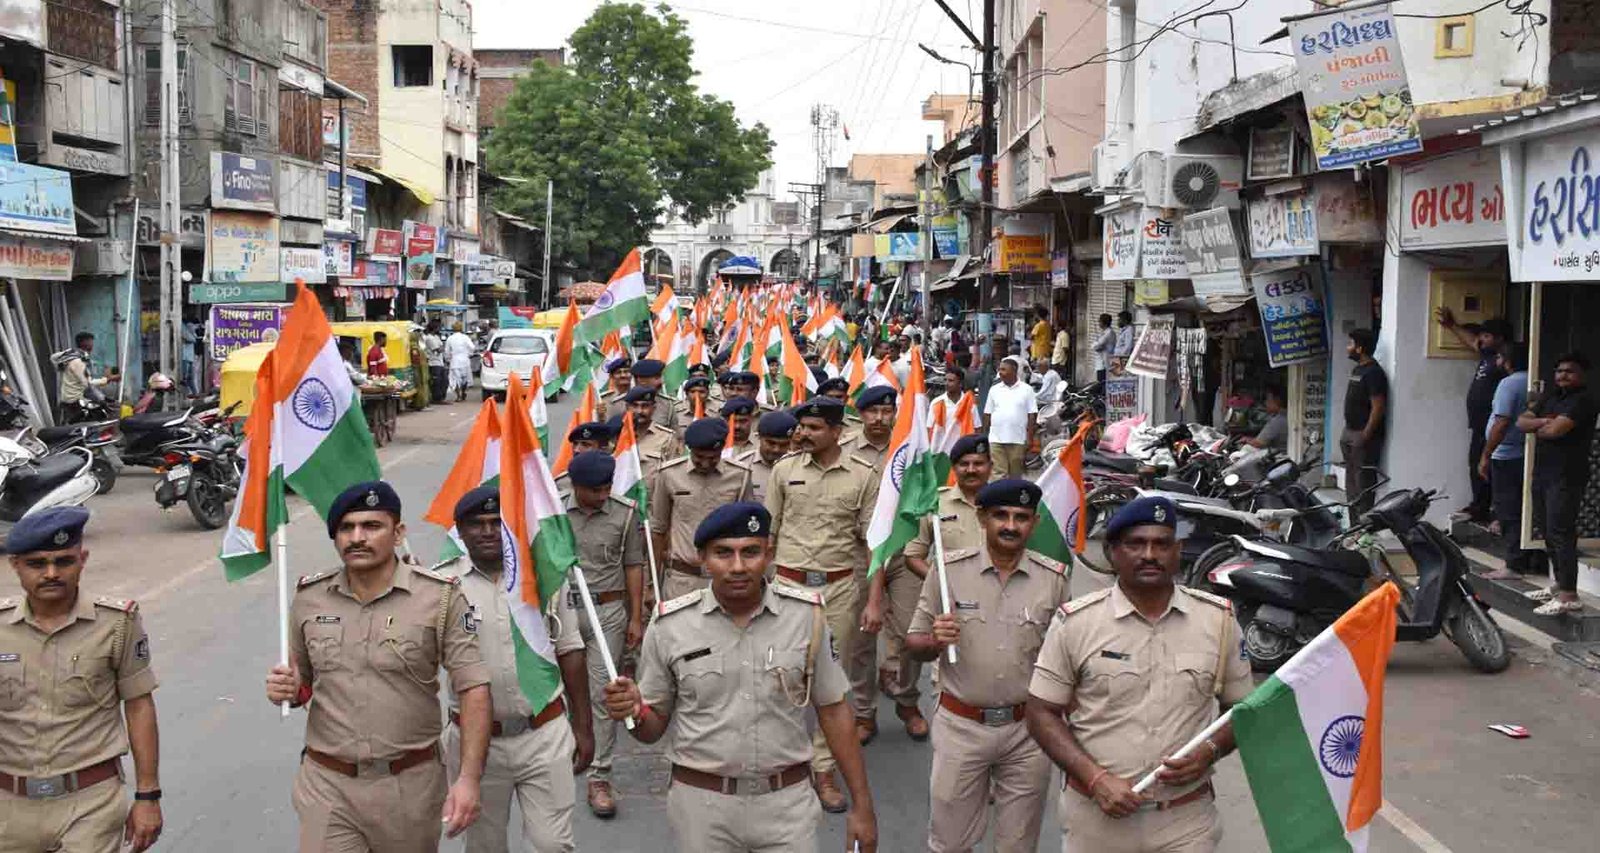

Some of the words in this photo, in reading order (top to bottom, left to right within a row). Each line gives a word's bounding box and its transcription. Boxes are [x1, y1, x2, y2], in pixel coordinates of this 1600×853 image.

[1326, 46, 1390, 73] પંજાબી
[232, 170, 251, 190] Fino
[1411, 182, 1474, 230] ભવ્ય
[1558, 252, 1580, 268] પાર્સલ
[206, 286, 241, 300] oppo
[219, 309, 249, 321] શ્રાવણ
[253, 310, 274, 321] માસ
[1263, 303, 1285, 321] હેર
[215, 327, 260, 340] રાજગરાના
